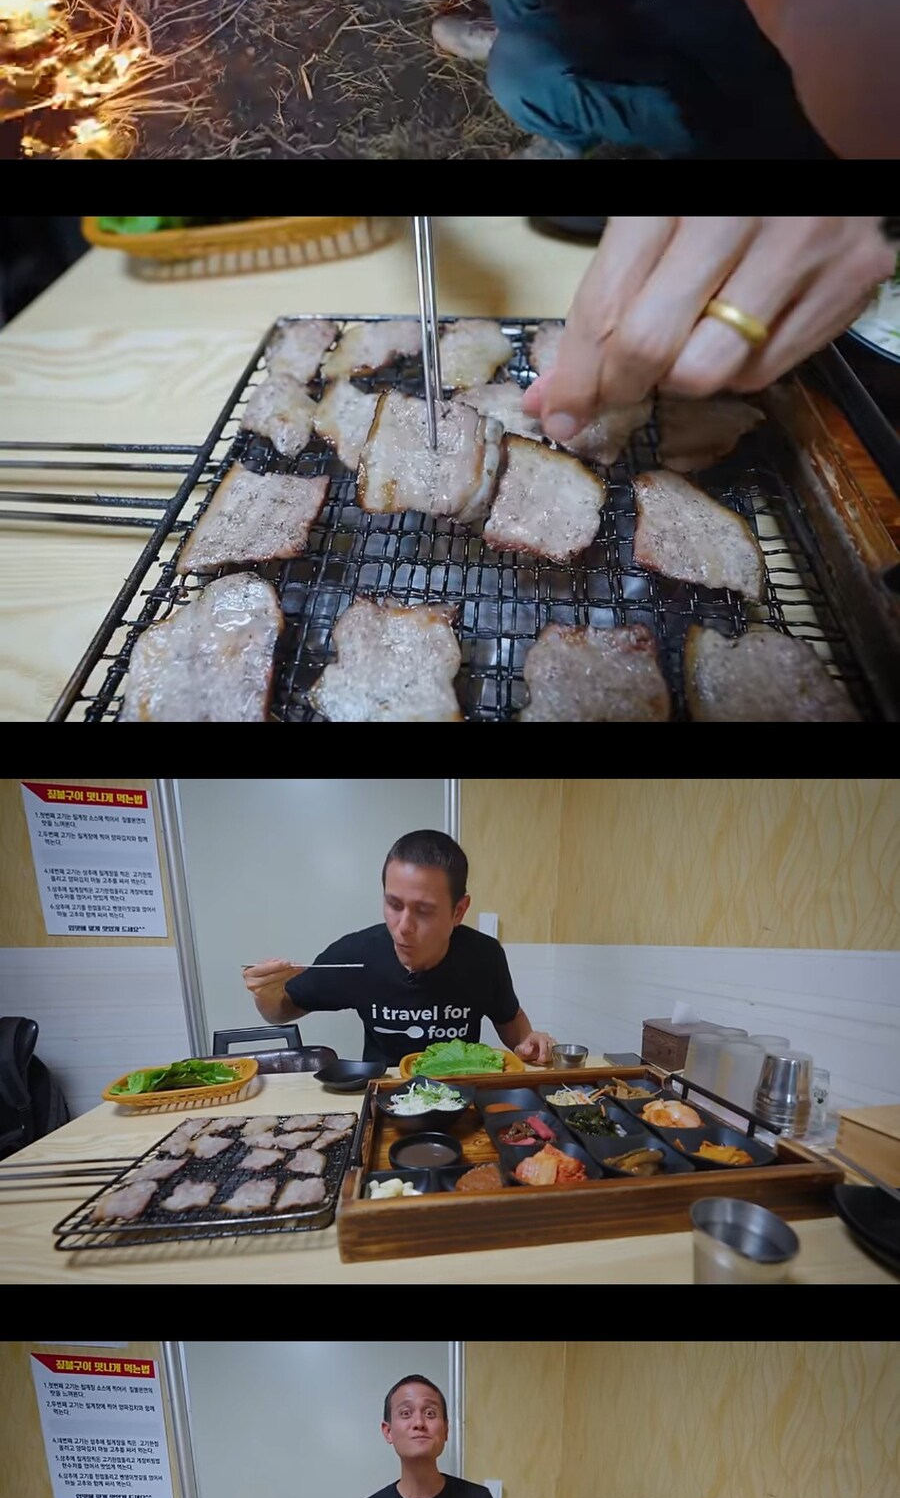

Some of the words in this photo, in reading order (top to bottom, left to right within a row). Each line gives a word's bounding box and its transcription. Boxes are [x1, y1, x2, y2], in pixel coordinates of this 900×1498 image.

[372, 1004, 377, 1019] i
[382, 1006, 438, 1020] travel
[444, 1005, 471, 1019] for
[428, 1023, 469, 1039] food
